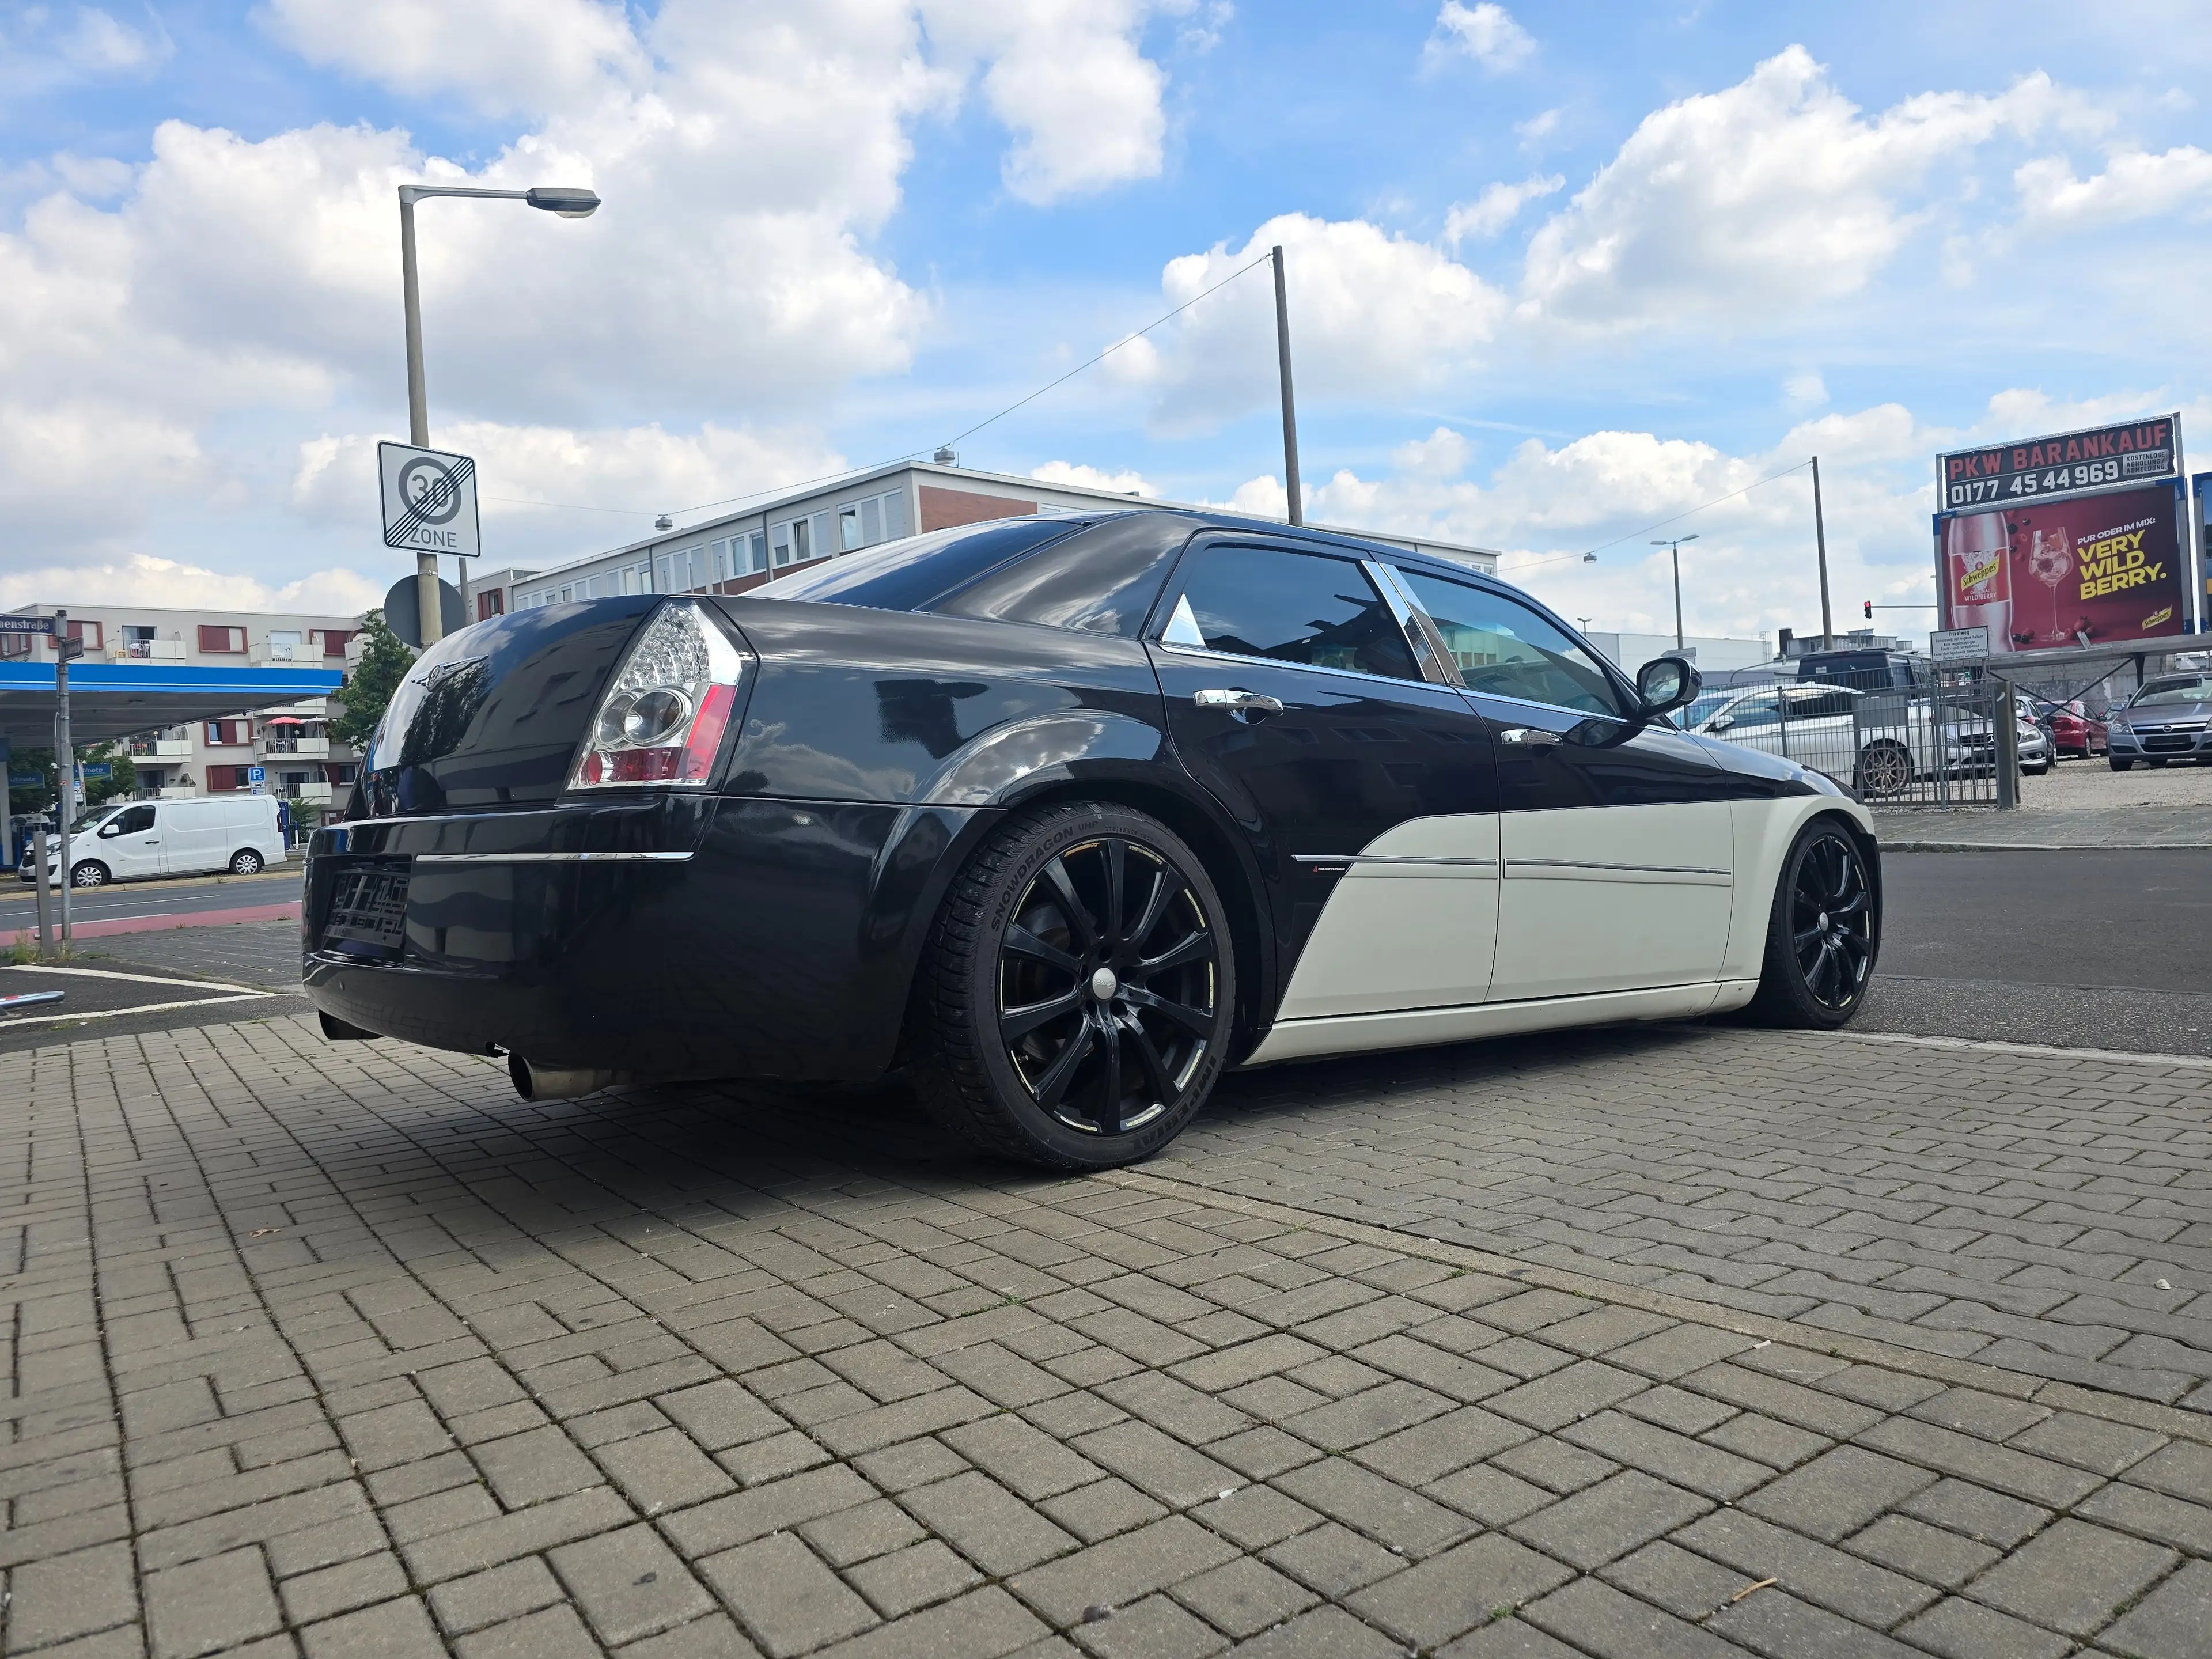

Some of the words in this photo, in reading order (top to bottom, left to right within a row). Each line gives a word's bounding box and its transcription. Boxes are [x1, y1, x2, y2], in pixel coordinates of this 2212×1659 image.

[1949, 452, 2002, 480] PKW
[2013, 424, 2166, 470] BARANKAUF
[2126, 452, 2165, 461] KOSTENLOSE
[2126, 459, 2165, 468] ABHOLUNG/
[2126, 464, 2165, 474] ABMELDUNG
[412, 474, 448, 507] 30
[1951, 479, 1999, 504] 0177
[410, 527, 457, 547] ZONE
[2077, 534, 2096, 545] PUR
[2097, 527, 2123, 539] ODER
[2124, 522, 2134, 532] IM
[2136, 517, 2156, 528] MIX:
[2077, 529, 2145, 563] VERY
[1963, 563, 1997, 586] Schweppes
[2079, 550, 2145, 581] WILD
[2080, 562, 2166, 600] BERRY.
[2145, 612, 2169, 627] Schweppes
[253, 768, 261, 779] P
[991, 826, 1074, 932] SNOWDRAGON
[1078, 821, 1099, 831] UHP
